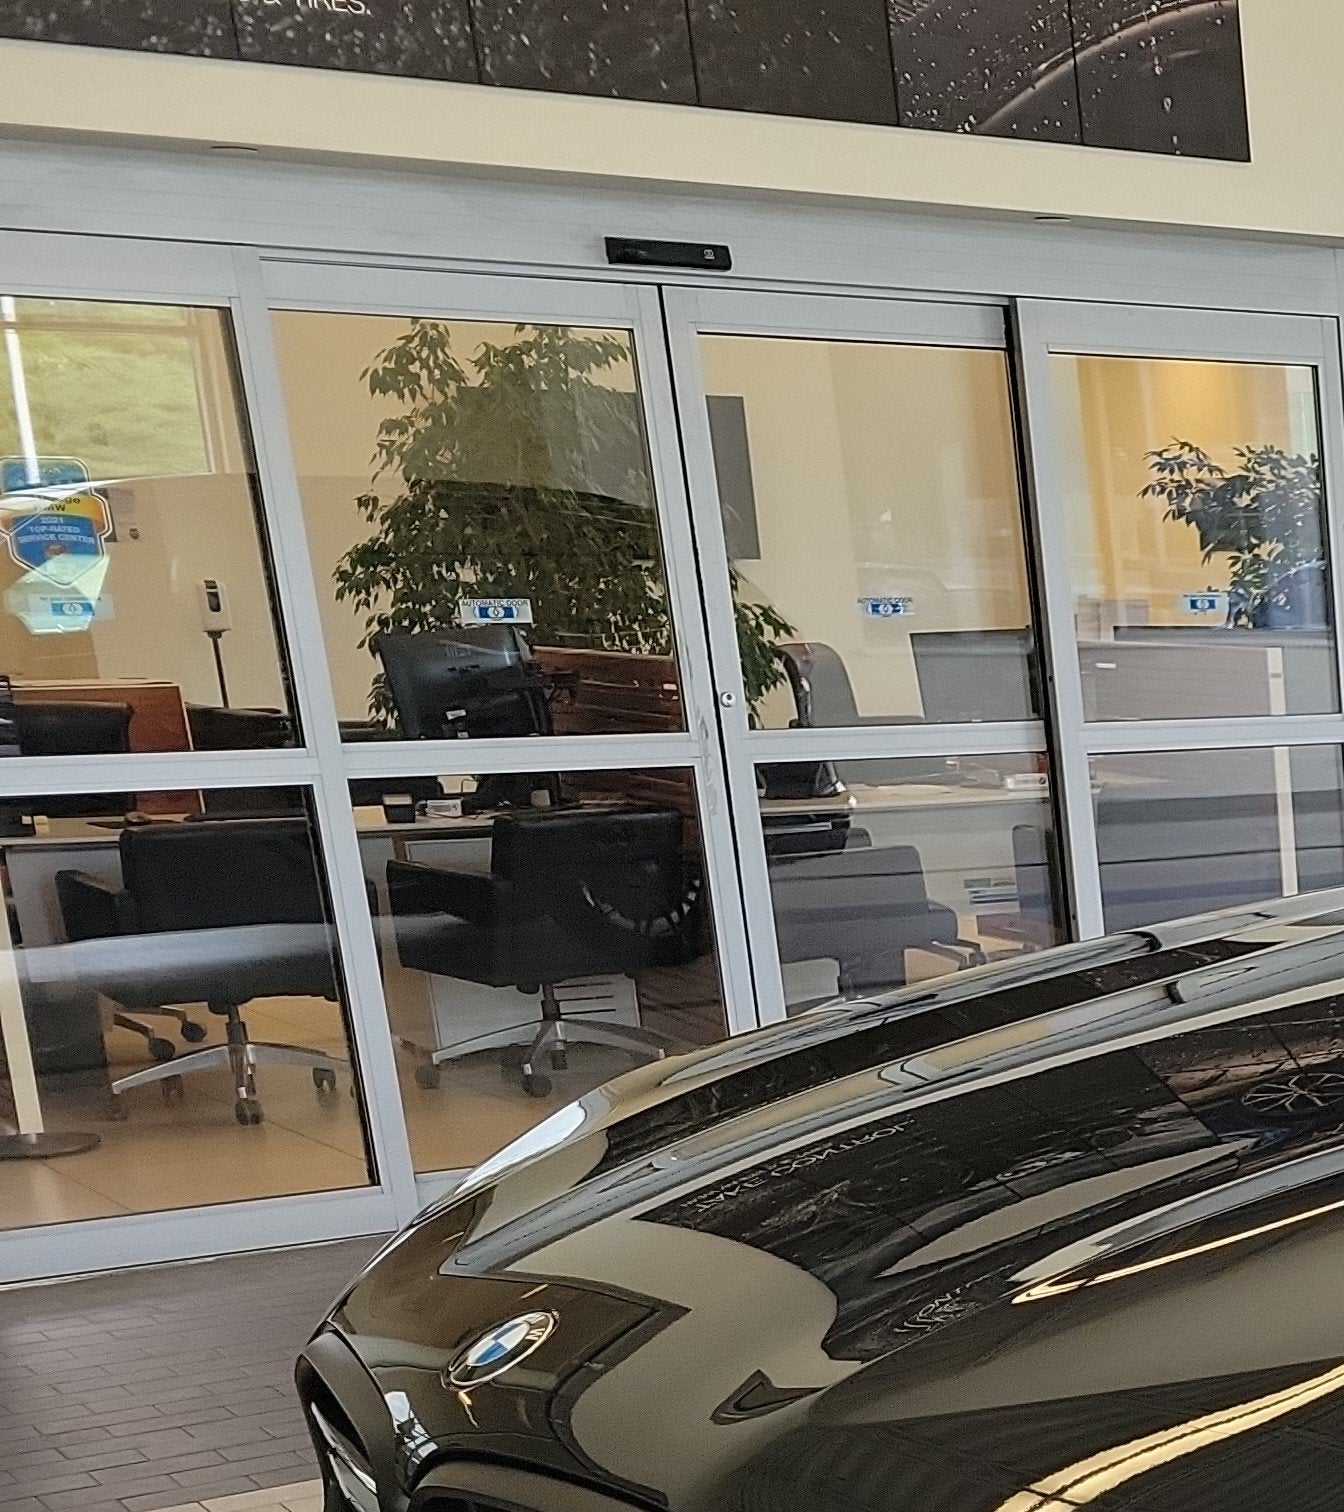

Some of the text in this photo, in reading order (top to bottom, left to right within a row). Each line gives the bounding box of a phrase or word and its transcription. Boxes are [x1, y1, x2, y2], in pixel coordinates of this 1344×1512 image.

[29, 525, 81, 534] TOP-RATED
[18, 534, 96, 545] SERVICE CENTER
